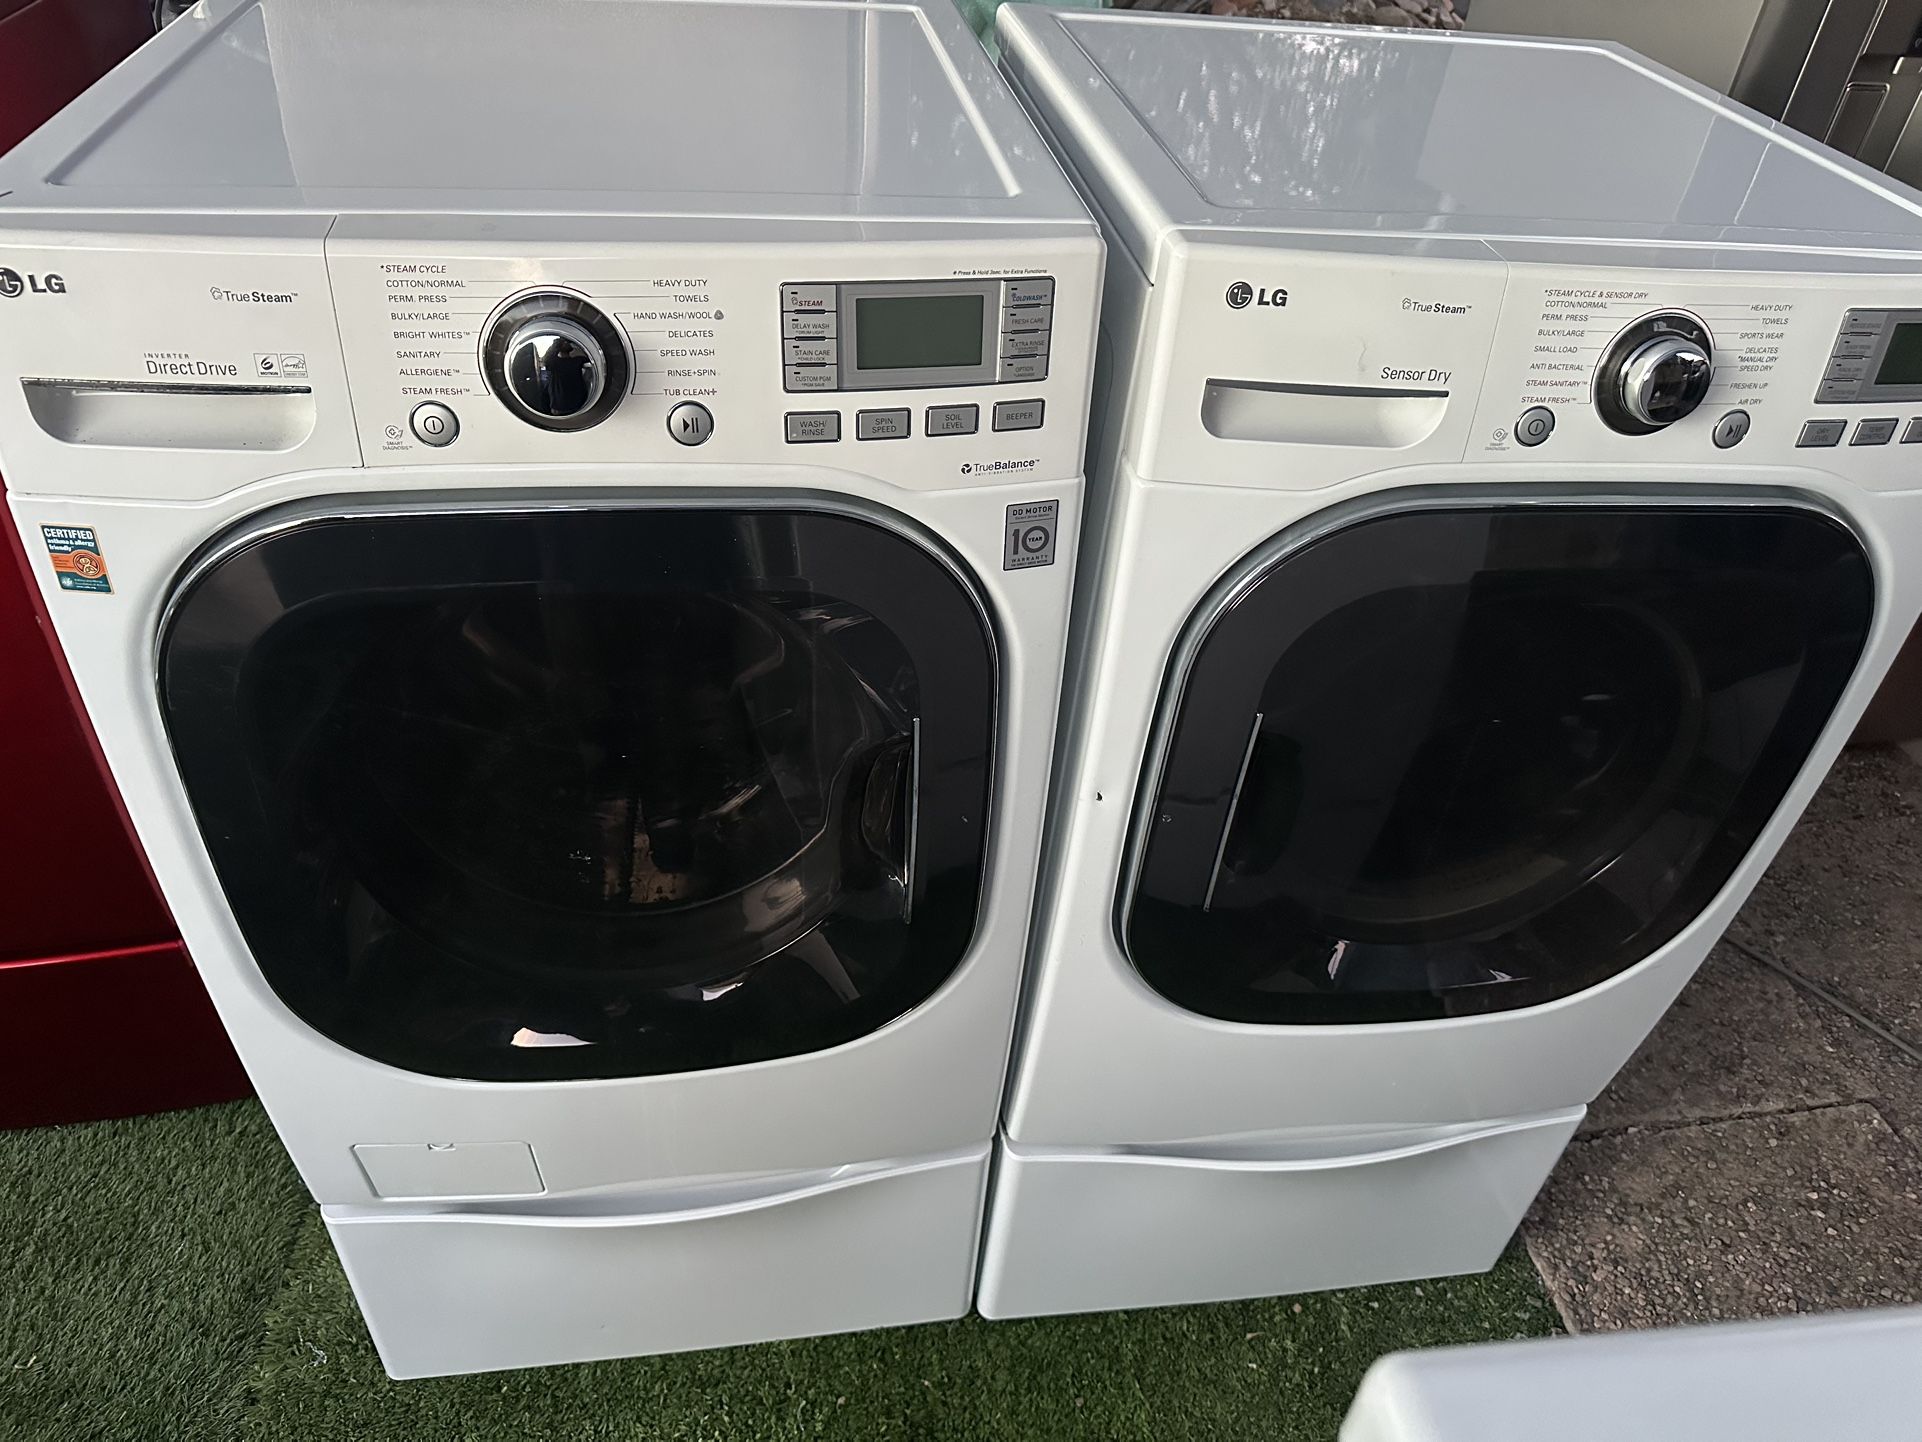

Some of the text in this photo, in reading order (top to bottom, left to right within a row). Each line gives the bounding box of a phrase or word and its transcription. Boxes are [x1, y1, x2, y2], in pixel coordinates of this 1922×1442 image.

[418, 265, 447, 274] CYCLE
[27, 273, 66, 293] LG
[386, 280, 466, 288] COTTON/NORMAL
[684, 279, 708, 287] DUTY
[388, 294, 448, 302] PERM. PRESS
[672, 294, 710, 302] TOWELS
[1257, 288, 1288, 307] LG
[1574, 290, 1596, 298] CYCLE
[1604, 291, 1634, 299] SENSOR
[1544, 300, 1608, 309] COTTON/NORMAL
[390, 312, 450, 320] BULKY/LARGE
[660, 311, 712, 320] WASH/WOOL
[668, 330, 714, 338] DELICATES
[1537, 328, 1586, 337] BULKY/LARGE
[396, 350, 441, 359] SANITARY
[688, 348, 715, 356] WASH
[667, 368, 716, 377] RINSE+SPIN
[1548, 364, 1585, 372] BACTERIAL
[1380, 366, 1452, 385] Sensor Dry
[402, 387, 433, 395] STEAM
[1006, 412, 1034, 421] BEEPER
[800, 420, 828, 428] WASH/
[942, 421, 964, 430] LEVEL
[801, 428, 825, 436] RINSE
[872, 425, 897, 433] SPEED
[1026, 506, 1053, 515] MOTOR
[44, 528, 94, 540] CERTIFIED
[1012, 526, 1050, 556] 10
[1012, 554, 1048, 563] WARRANTY
